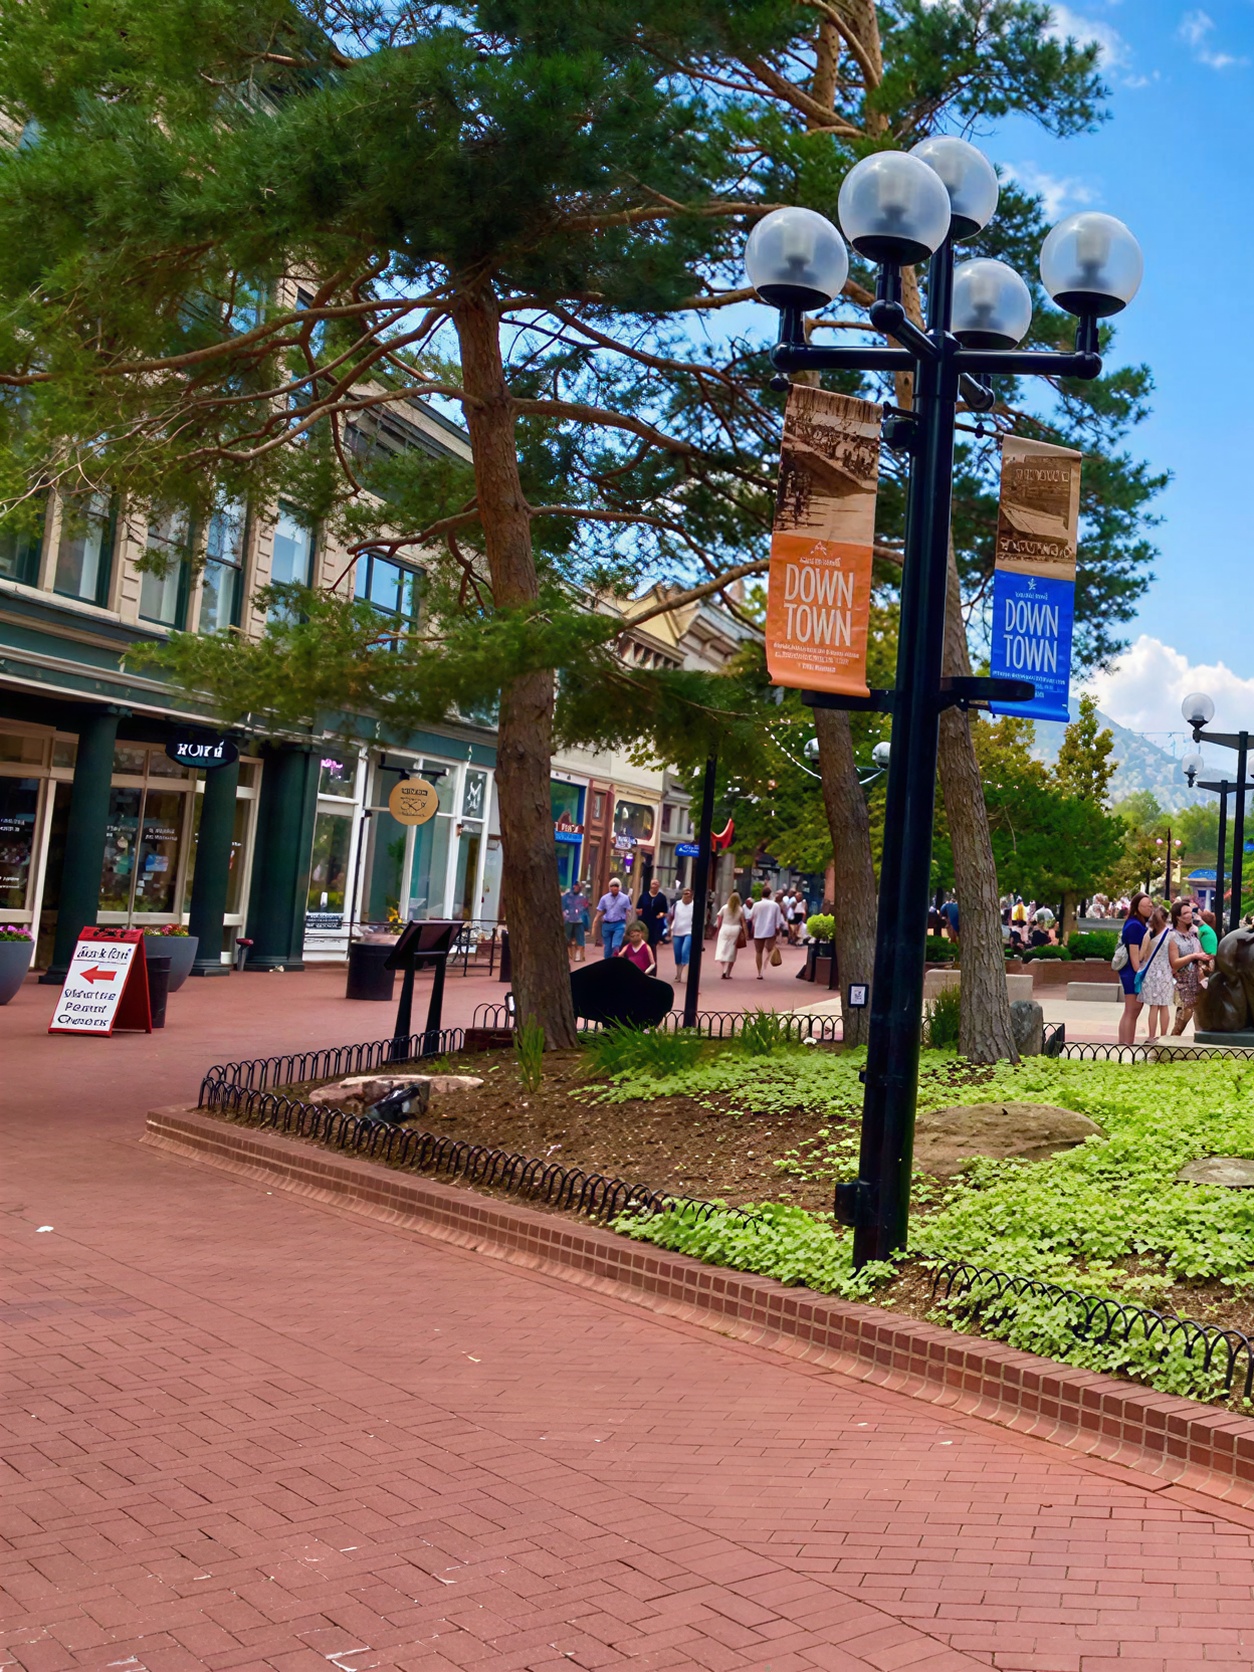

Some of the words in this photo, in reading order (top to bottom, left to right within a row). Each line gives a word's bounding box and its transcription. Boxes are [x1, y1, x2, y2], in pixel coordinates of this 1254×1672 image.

[784, 563, 854, 609] DOWN
[783, 603, 852, 647] TOWN
[1005, 599, 1059, 638] DOWN
[1003, 634, 1058, 673] TOWN
